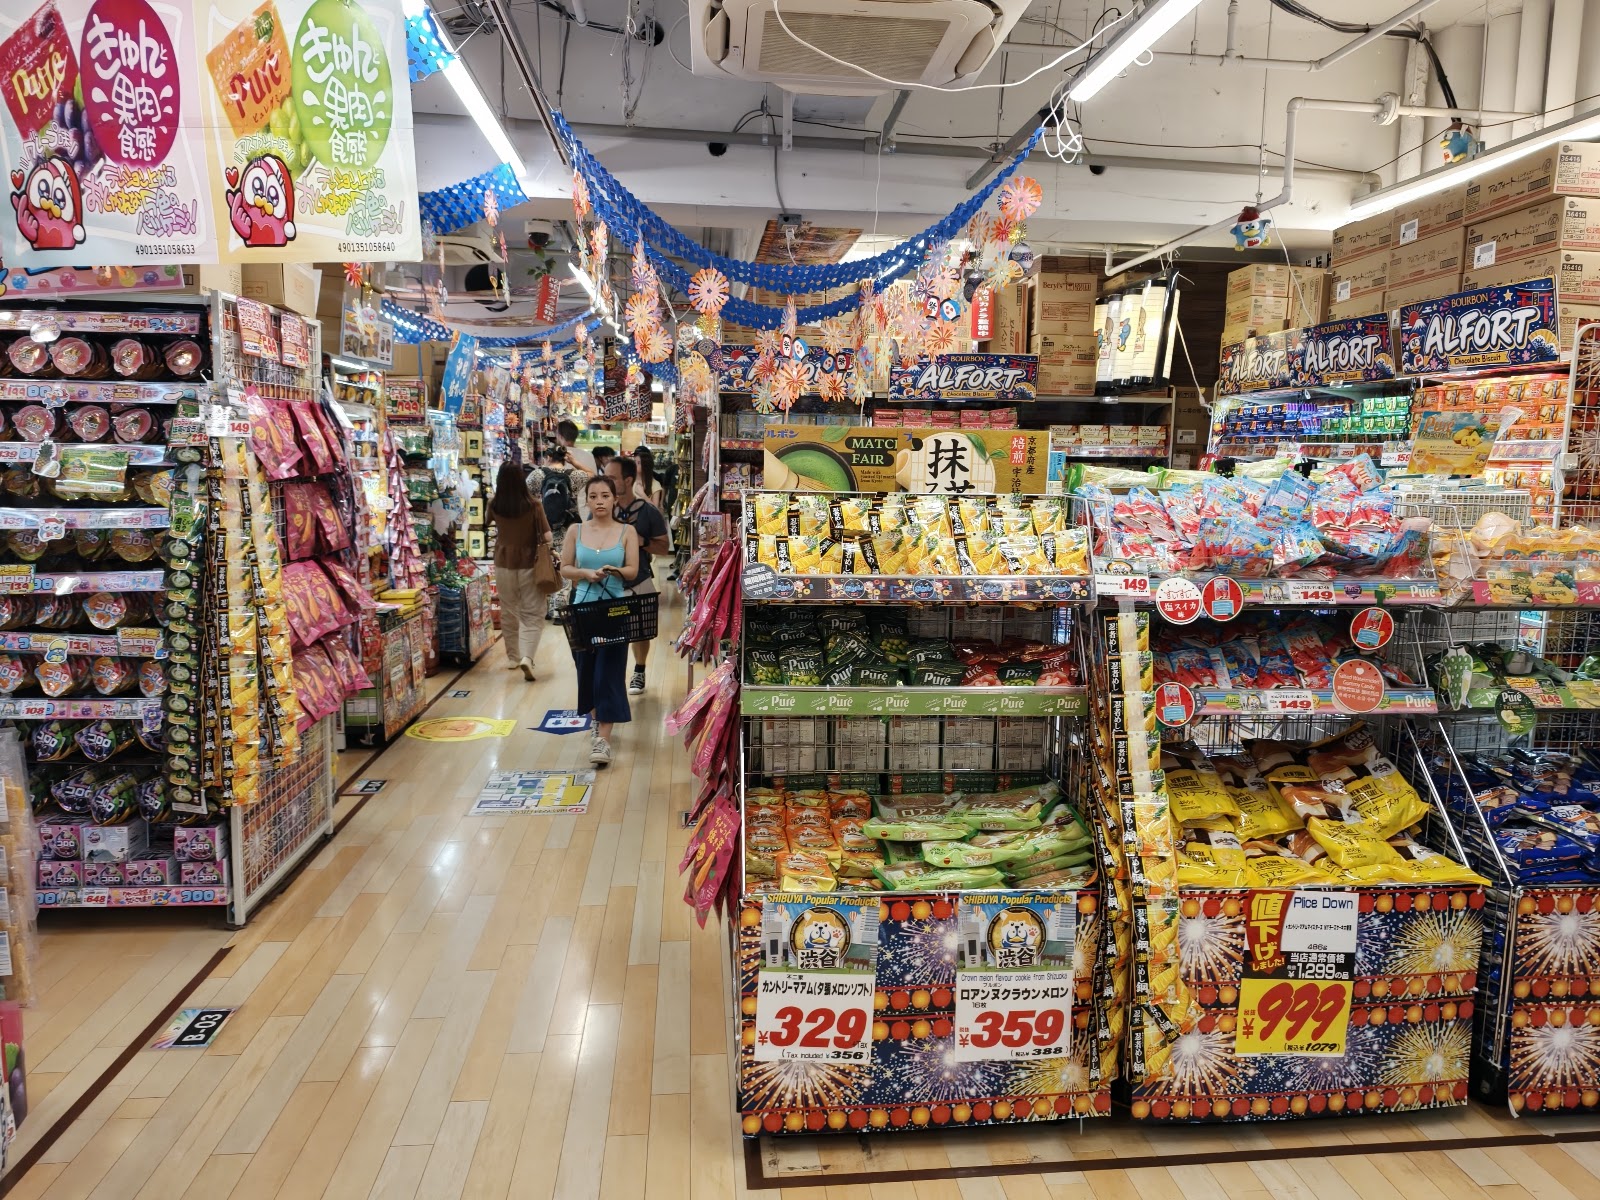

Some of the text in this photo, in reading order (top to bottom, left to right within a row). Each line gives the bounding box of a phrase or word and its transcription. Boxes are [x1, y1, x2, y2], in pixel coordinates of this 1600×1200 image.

[87, 14, 168, 80] きゅんと
[300, 18, 380, 83] きゅんと
[112, 72, 162, 125] 果肉
[324, 76, 373, 130] 果肉
[118, 125, 157, 160] 食感
[329, 129, 368, 165] 食感
[1561, 155, 1581, 163] 36416
[103, 164, 178, 189] テンション上がる
[315, 167, 386, 191] テンション上がる
[136, 244, 196, 255] 4901351058633
[338, 242, 396, 253] 4901351058640
[1451, 293, 1489, 308] BOURBON
[1321, 324, 1347, 334] BOURBON
[1425, 307, 1538, 355] ALFORT
[1306, 335, 1381, 373] ALFORT
[1482, 355, 1501, 363] Biscuit
[1230, 350, 1287, 382] ALFORT
[918, 364, 1026, 391] ALFORT
[604, 393, 625, 407] BEEF
[605, 404, 628, 420] JERKY
[230, 422, 250, 433] 149
[1424, 415, 1457, 433] Puré
[852, 438, 898, 449] MATC
[1011, 437, 1024, 464] 焙煎
[1026, 436, 1038, 475] 京都府産
[852, 453, 885, 465] FAIR
[1123, 579, 1148, 590] 149
[1300, 591, 1333, 600] 149
[1410, 584, 1436, 599] Puré
[1164, 601, 1197, 612] 塩スイカ
[789, 659, 815, 671] Puré
[860, 669, 889, 679] Puré
[924, 672, 951, 685] Puré
[772, 695, 796, 707] Puré
[829, 695, 853, 707] Puré
[886, 696, 909, 708] Puré
[943, 697, 967, 708] Puré
[1001, 697, 1025, 708] Puré
[1405, 694, 1431, 708] Puré
[1502, 691, 1523, 702] Puré
[1057, 698, 1081, 709] Puré
[1279, 700, 1312, 709] 149
[25, 707, 45, 715] 108
[182, 890, 215, 902] コロロ
[767, 894, 878, 907] SHIBUYA Popular Products
[964, 894, 1072, 905] SHIBUYA Popular Products
[1323, 897, 1353, 909] Down
[1135, 908, 1149, 951] 忍者めし鋼
[1250, 893, 1287, 960] 値下げ
[800, 949, 838, 969] 渋谷
[999, 947, 1035, 968] 渋谷
[1290, 953, 1345, 963] 当店通常価格
[1252, 958, 1285, 971] しました!
[995, 973, 1013, 982] flavour
[763, 980, 873, 997] カントリーマアム(夕張メロンソフト)
[961, 987, 1069, 1000] ロアンヌクラウンメロン
[182, 1013, 223, 1042] B-03
[1134, 1032, 1145, 1074] 忍者めし鋼
